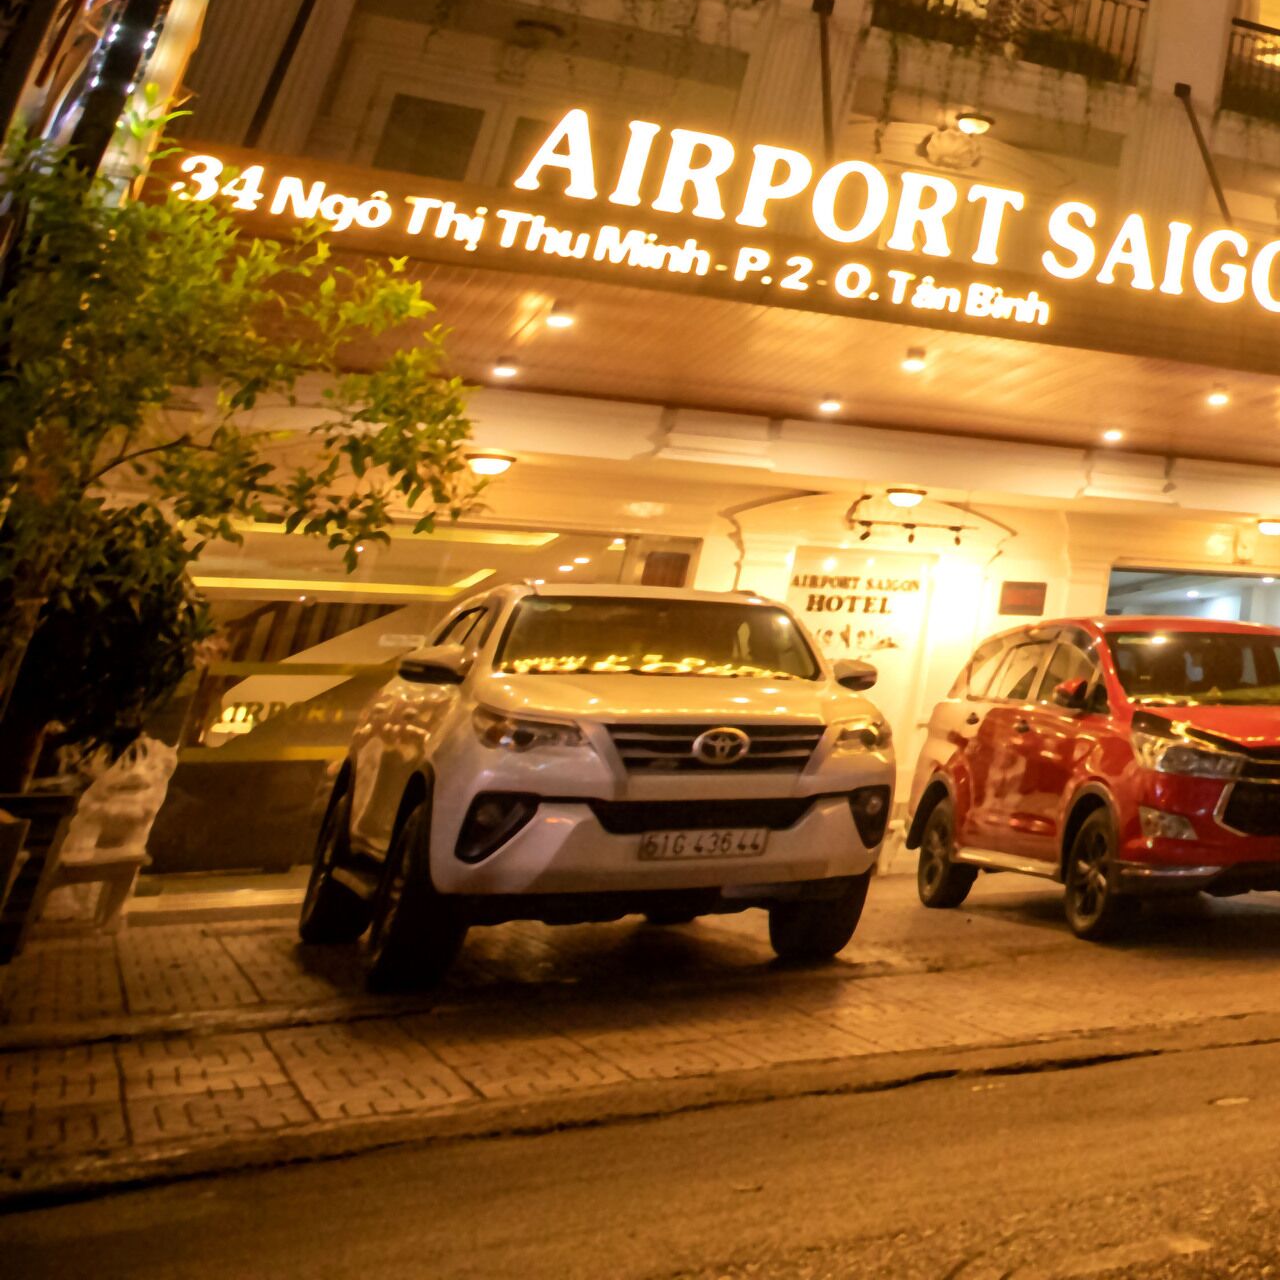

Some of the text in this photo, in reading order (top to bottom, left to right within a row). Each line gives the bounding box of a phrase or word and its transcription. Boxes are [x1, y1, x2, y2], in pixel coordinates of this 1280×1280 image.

[170, 154, 265, 211] 34
[270, 176, 392, 232] Ngô
[404, 195, 488, 252] Thị
[496, 208, 590, 260] Thu
[594, 224, 710, 276] Minh
[514, 108, 1025, 265] AIRPORT
[791, 574, 861, 590] AIRPORT
[806, 594, 891, 614] HOTEL
